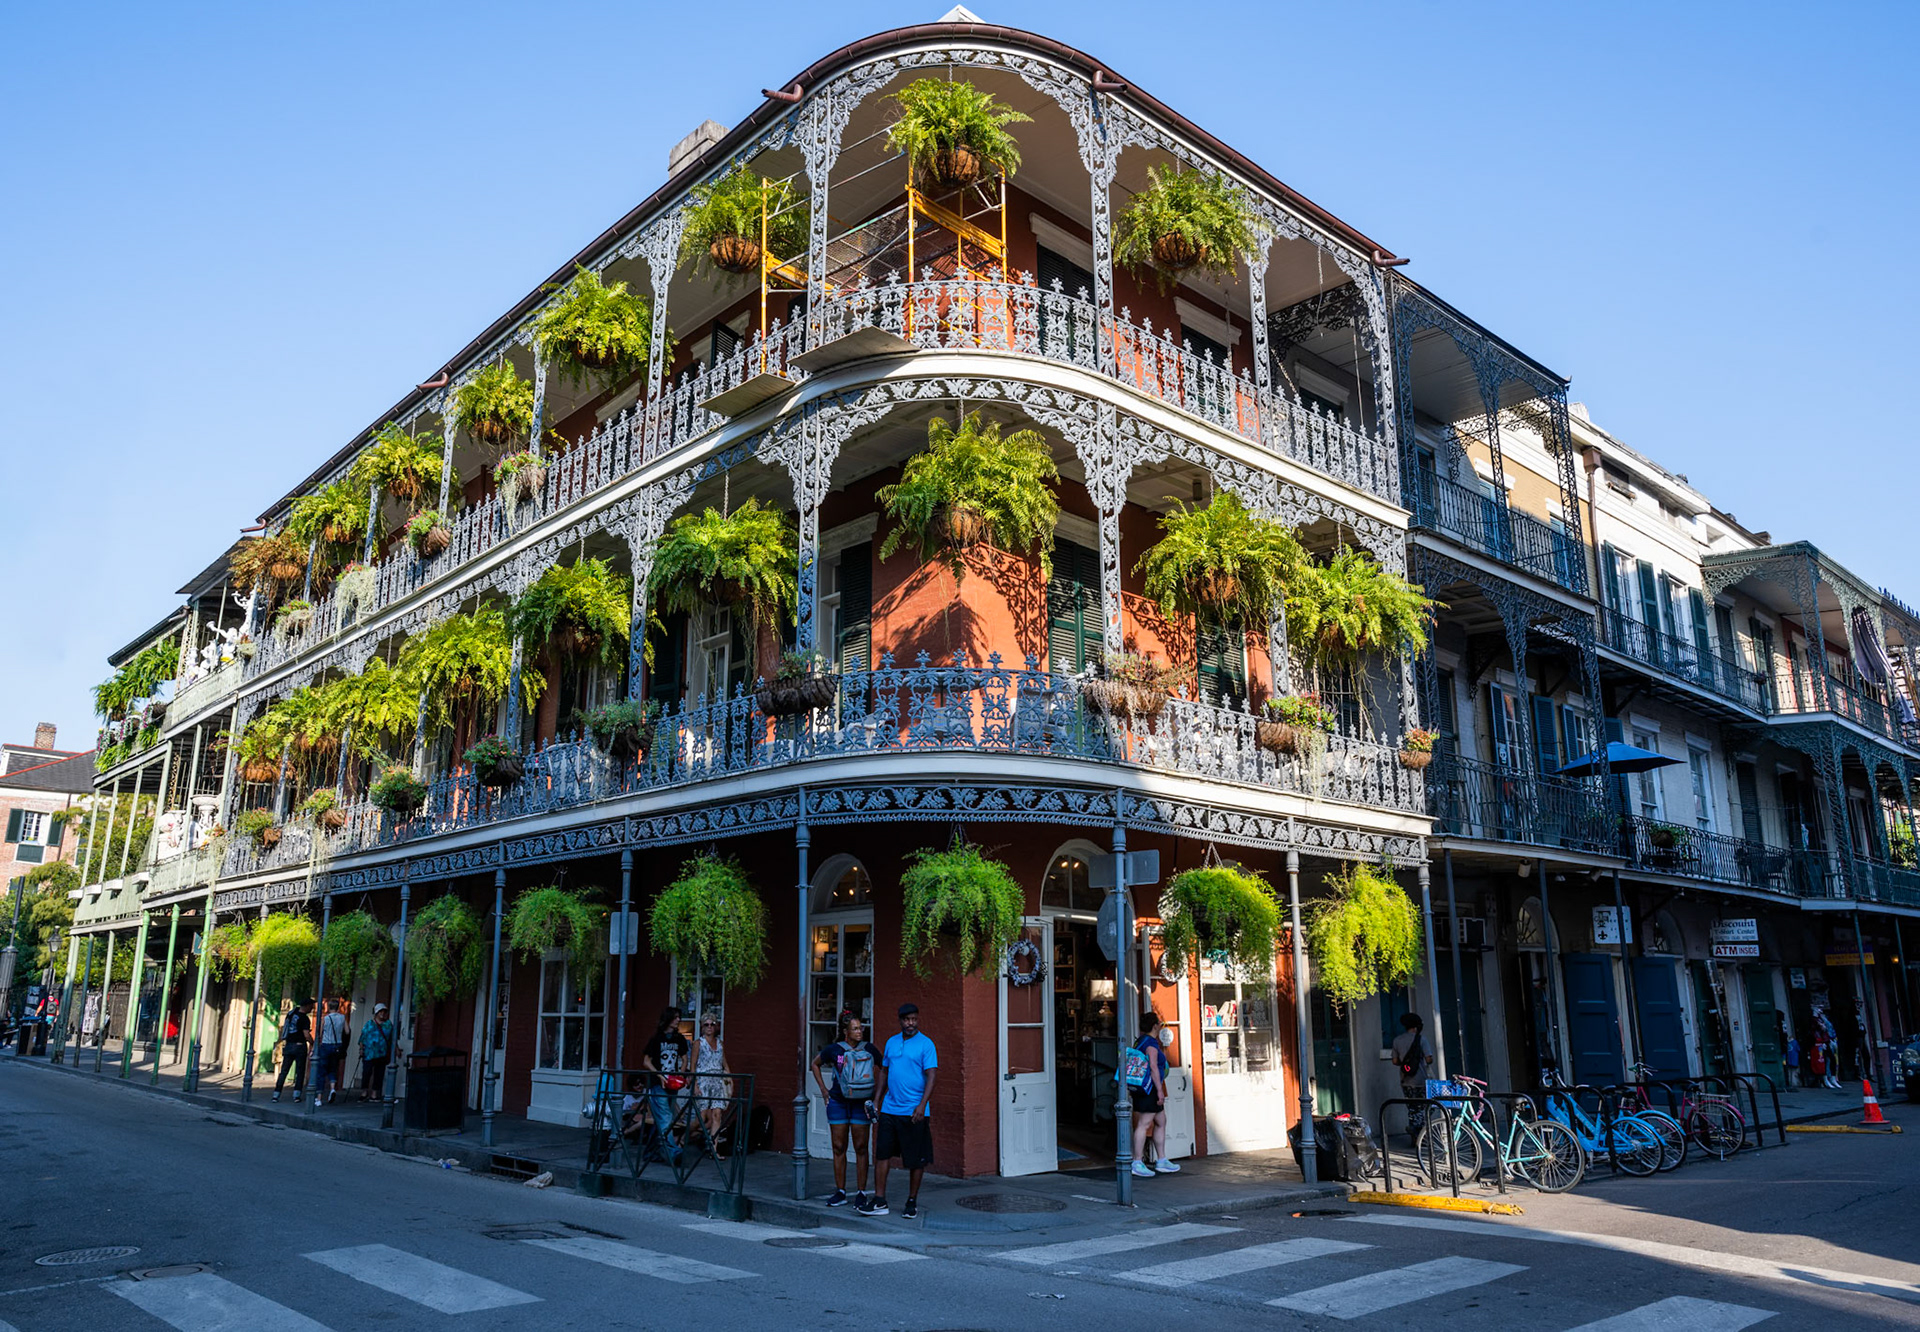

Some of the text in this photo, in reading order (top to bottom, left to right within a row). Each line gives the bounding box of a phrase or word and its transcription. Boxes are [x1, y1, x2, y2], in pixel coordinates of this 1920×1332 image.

[1712, 920, 1755, 928] Discount
[1715, 946, 1758, 955] ATM INSIDE
